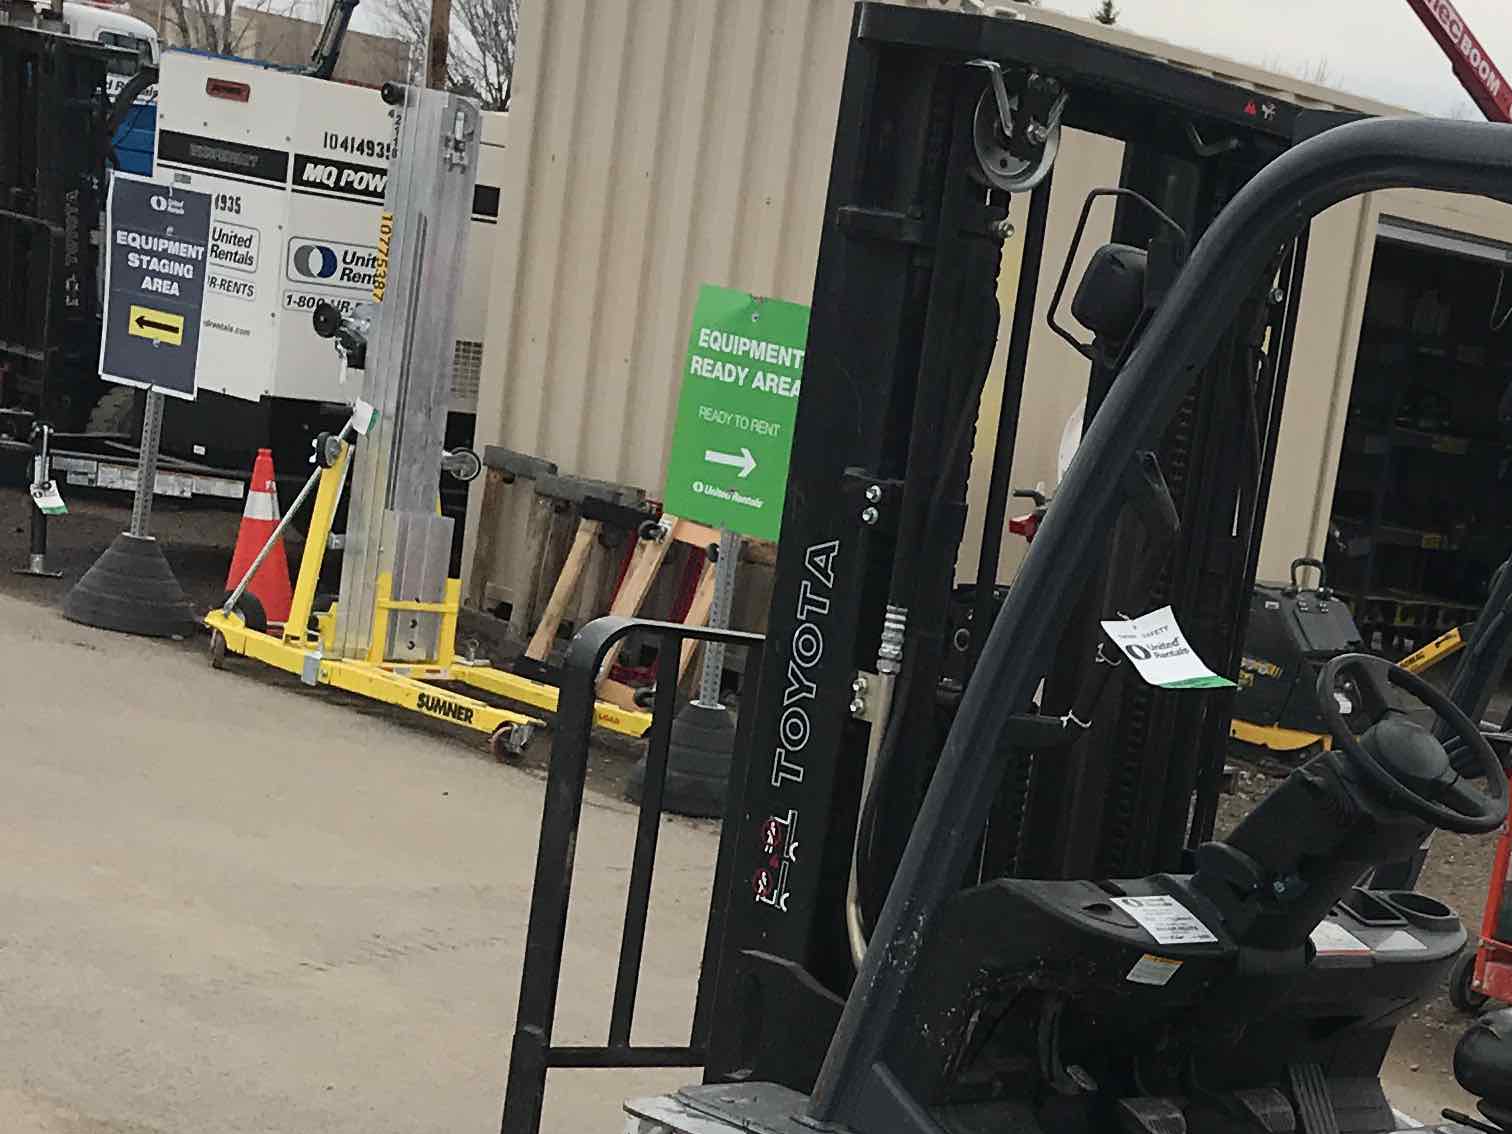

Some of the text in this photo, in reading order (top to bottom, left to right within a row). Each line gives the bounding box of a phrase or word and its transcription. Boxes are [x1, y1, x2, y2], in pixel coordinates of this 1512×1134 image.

[1460, 33, 1501, 97] BOOM
[303, 163, 387, 192] MQ POW
[116, 230, 204, 261] EQUIPMENT
[212, 226, 253, 249] United
[127, 253, 194, 279] STAGING
[210, 244, 254, 267] Rentals
[342, 250, 377, 268] Unit
[141, 276, 180, 297] AREA
[698, 327, 805, 369] EQUIPMENT
[690, 355, 801, 398] READY AREA
[698, 405, 781, 438] READY TO RENT
[771, 540, 840, 788] TOYOTA
[416, 691, 475, 727] SUMNER
